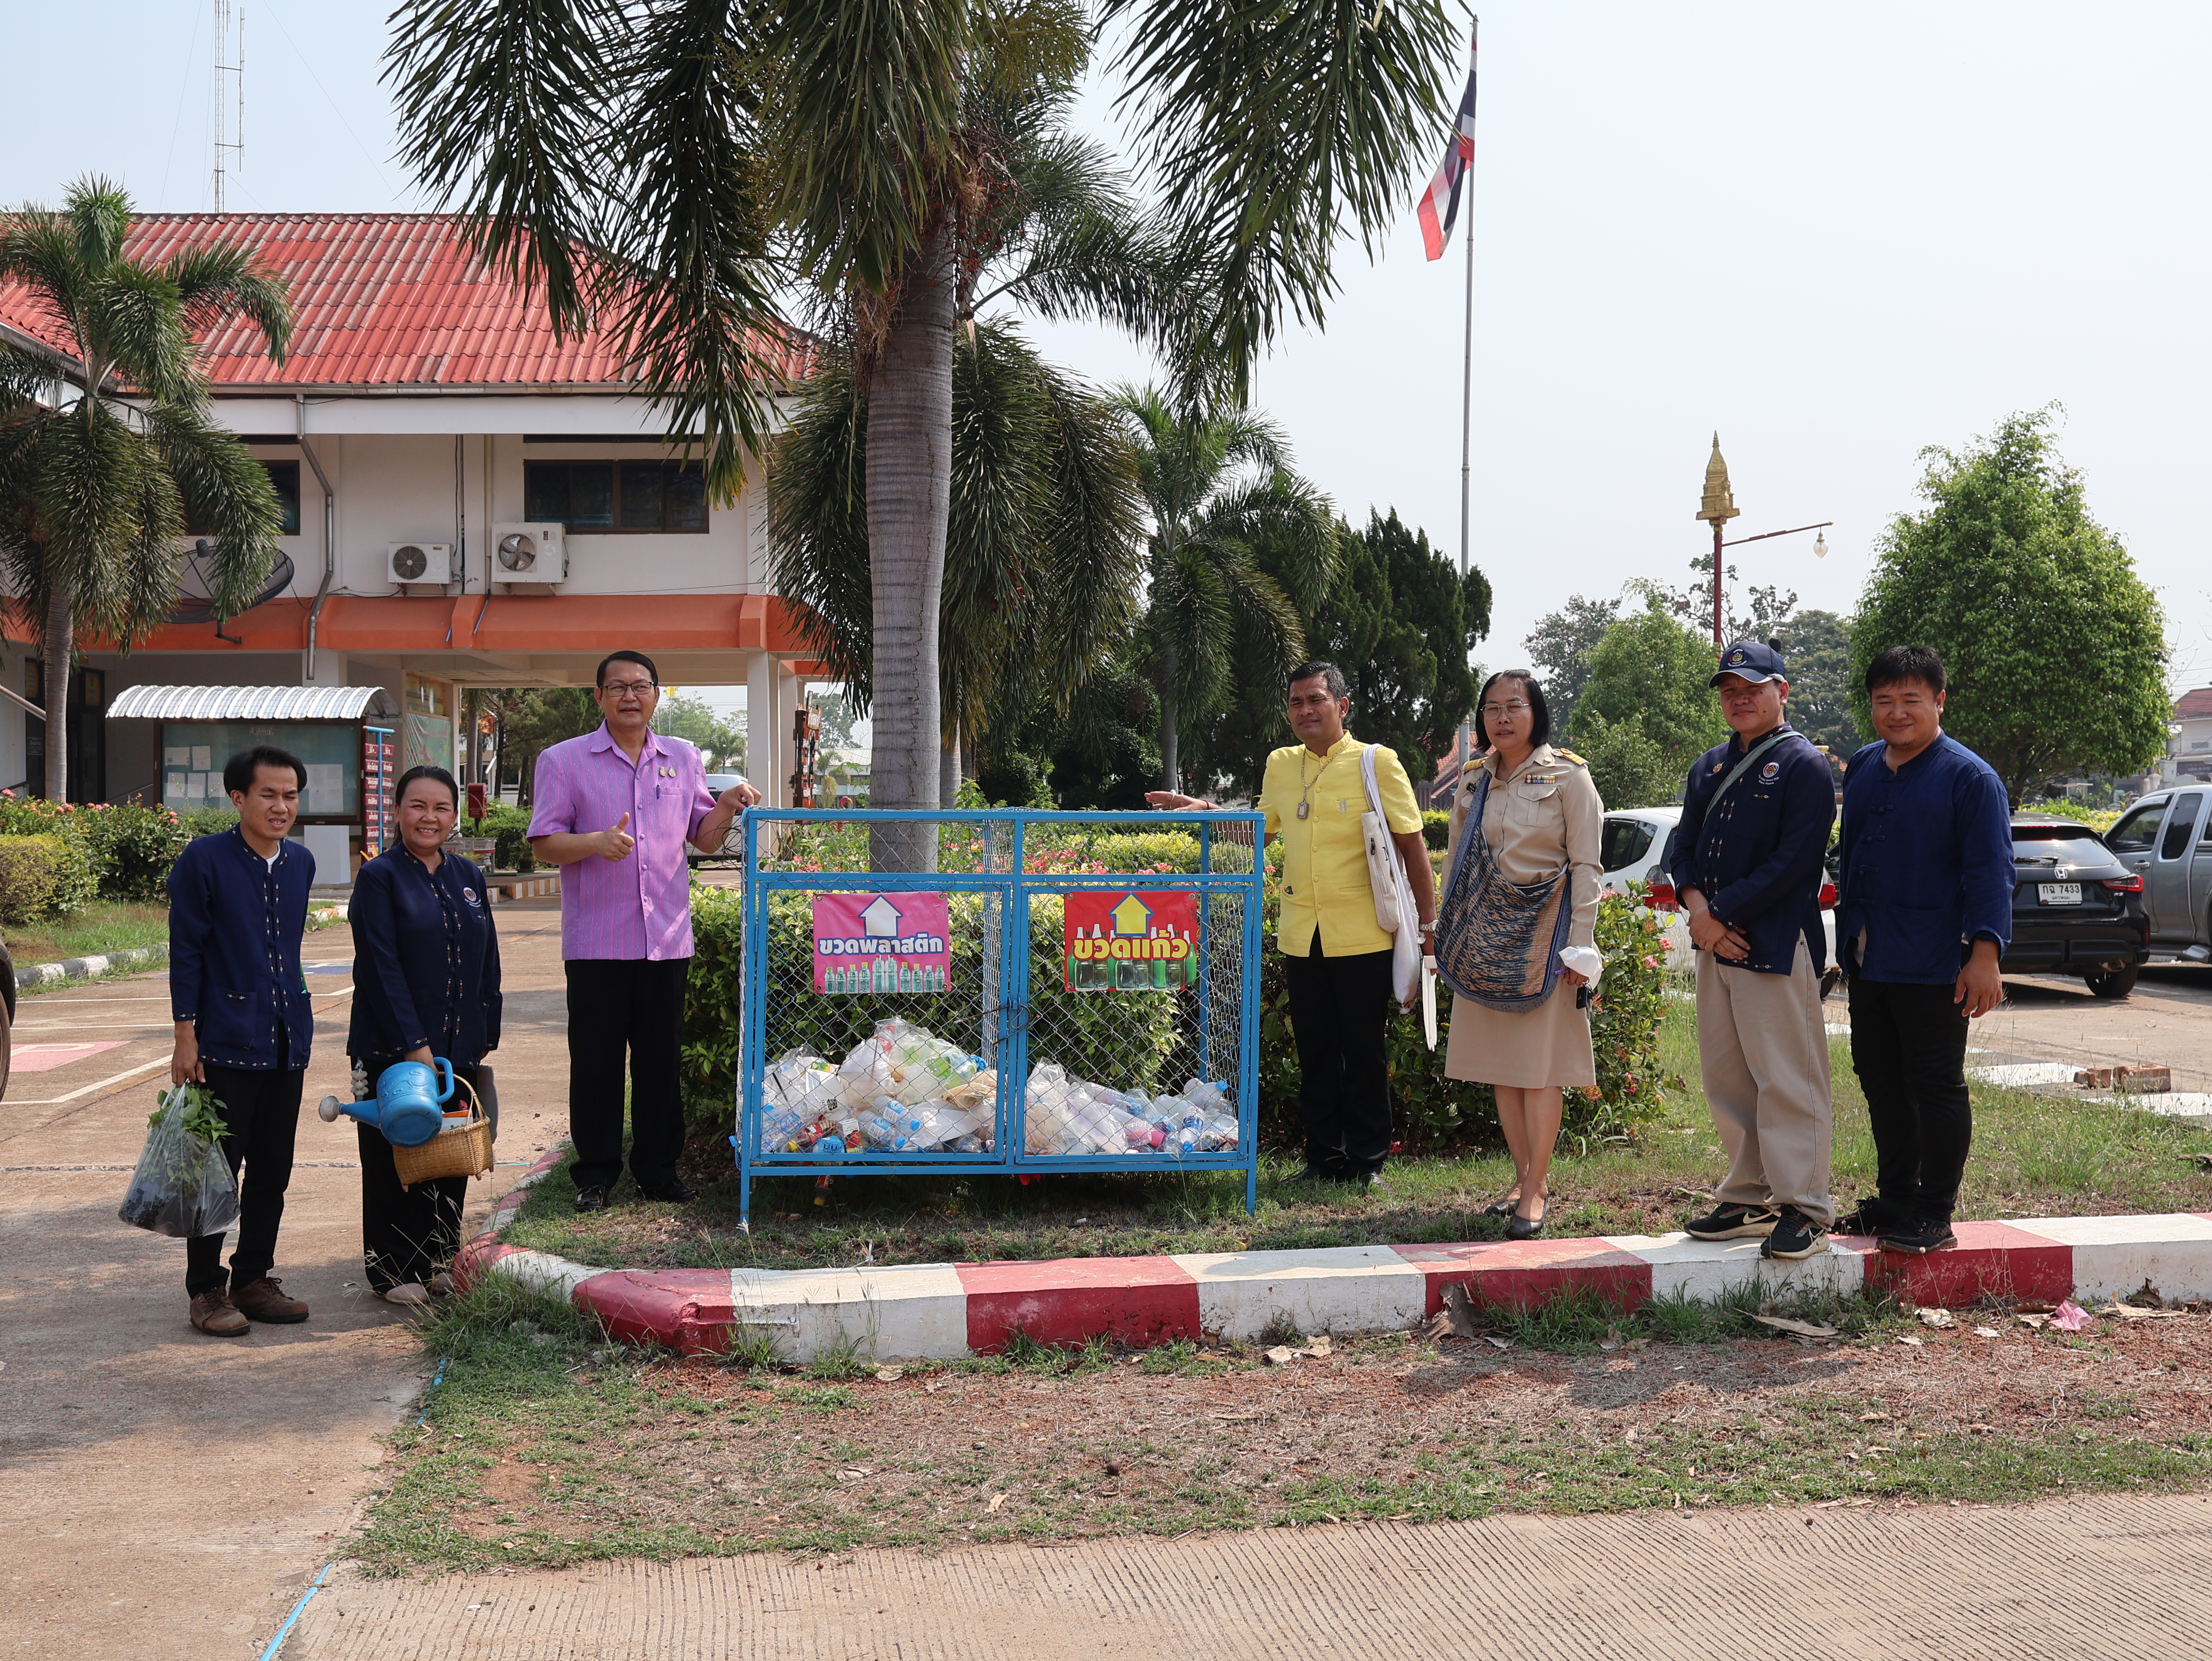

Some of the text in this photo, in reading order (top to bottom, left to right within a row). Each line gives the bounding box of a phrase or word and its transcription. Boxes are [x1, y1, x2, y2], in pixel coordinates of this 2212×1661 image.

[2059, 885, 2080, 894] 7433
[820, 933, 943, 954] ขวดพลาสติก
[1074, 930, 1188, 958] ขวดแก้ว
